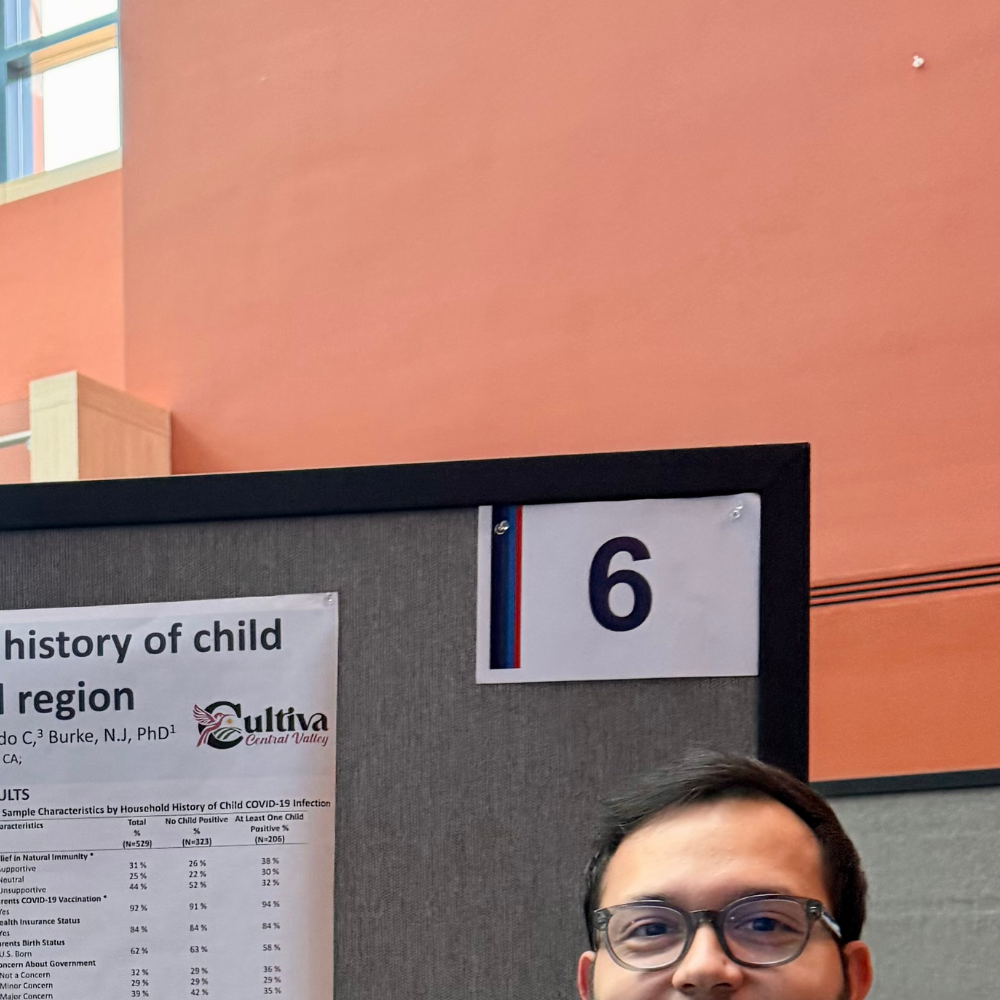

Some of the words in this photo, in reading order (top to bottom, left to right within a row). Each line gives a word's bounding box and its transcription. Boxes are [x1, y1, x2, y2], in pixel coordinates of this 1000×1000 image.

[588, 536, 653, 633] 6
[4, 629, 133, 664] history
[144, 622, 183, 655] of
[193, 617, 282, 653] child
[18, 680, 134, 721] region
[49, 728, 99, 746] Burke,
[104, 727, 132, 744] N.J,
[197, 701, 330, 751] Cultiva
[245, 734, 289, 747] Central
[291, 732, 330, 748] Valley
[2, 807, 36, 819] Sample
[37, 805, 105, 816] Characteristics
[106, 805, 119, 816] by
[120, 803, 170, 814] Household
[172, 802, 206, 813] History
[207, 801, 218, 811] of
[219, 800, 243, 811] Child
[245, 799, 290, 809] COVID-19
[293, 798, 331, 808] Infection
